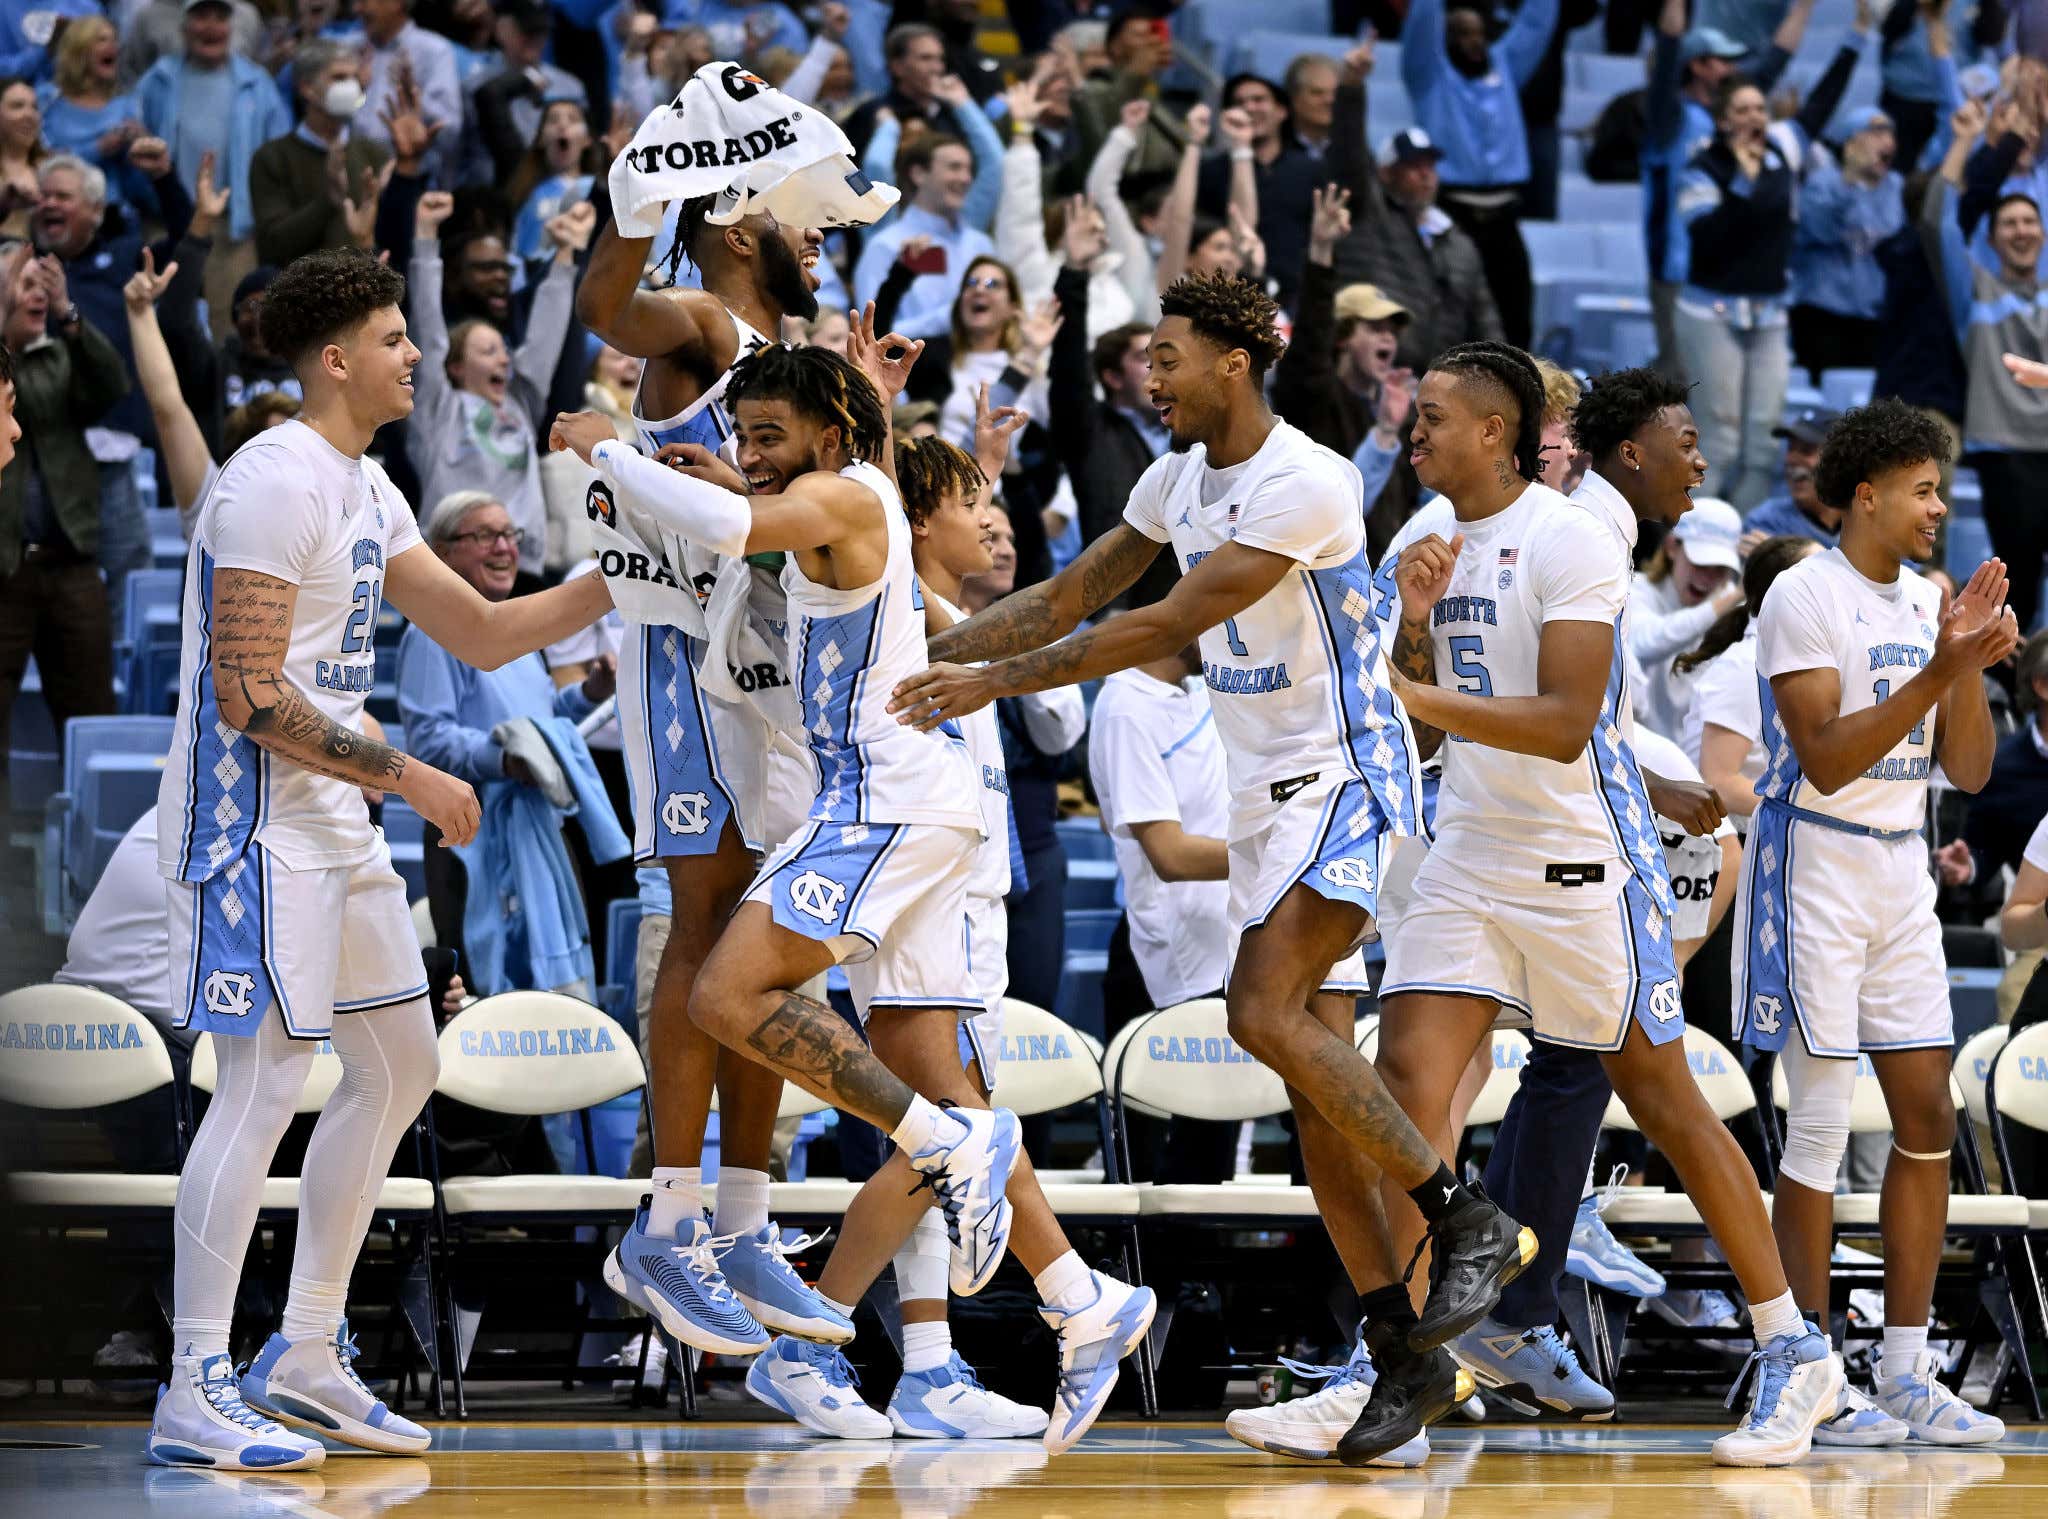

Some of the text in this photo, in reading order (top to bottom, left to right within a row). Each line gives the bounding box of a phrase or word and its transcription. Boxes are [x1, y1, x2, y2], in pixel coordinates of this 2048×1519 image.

[352, 538, 383, 573] NORTH
[595, 549, 680, 590] ORA
[341, 579, 380, 654] 21
[1433, 596, 1498, 628] NORTH
[1448, 635, 1494, 697] 5
[1868, 643, 1930, 671] NORTH
[315, 660, 375, 693] CAROLI
[1201, 659, 1292, 695] CAROLINA
[384, 748, 408, 781] 20
[1860, 757, 1929, 781] ROLIN
[0, 1023, 144, 1051] AROLINA
[459, 1026, 617, 1058] CAROLINA
